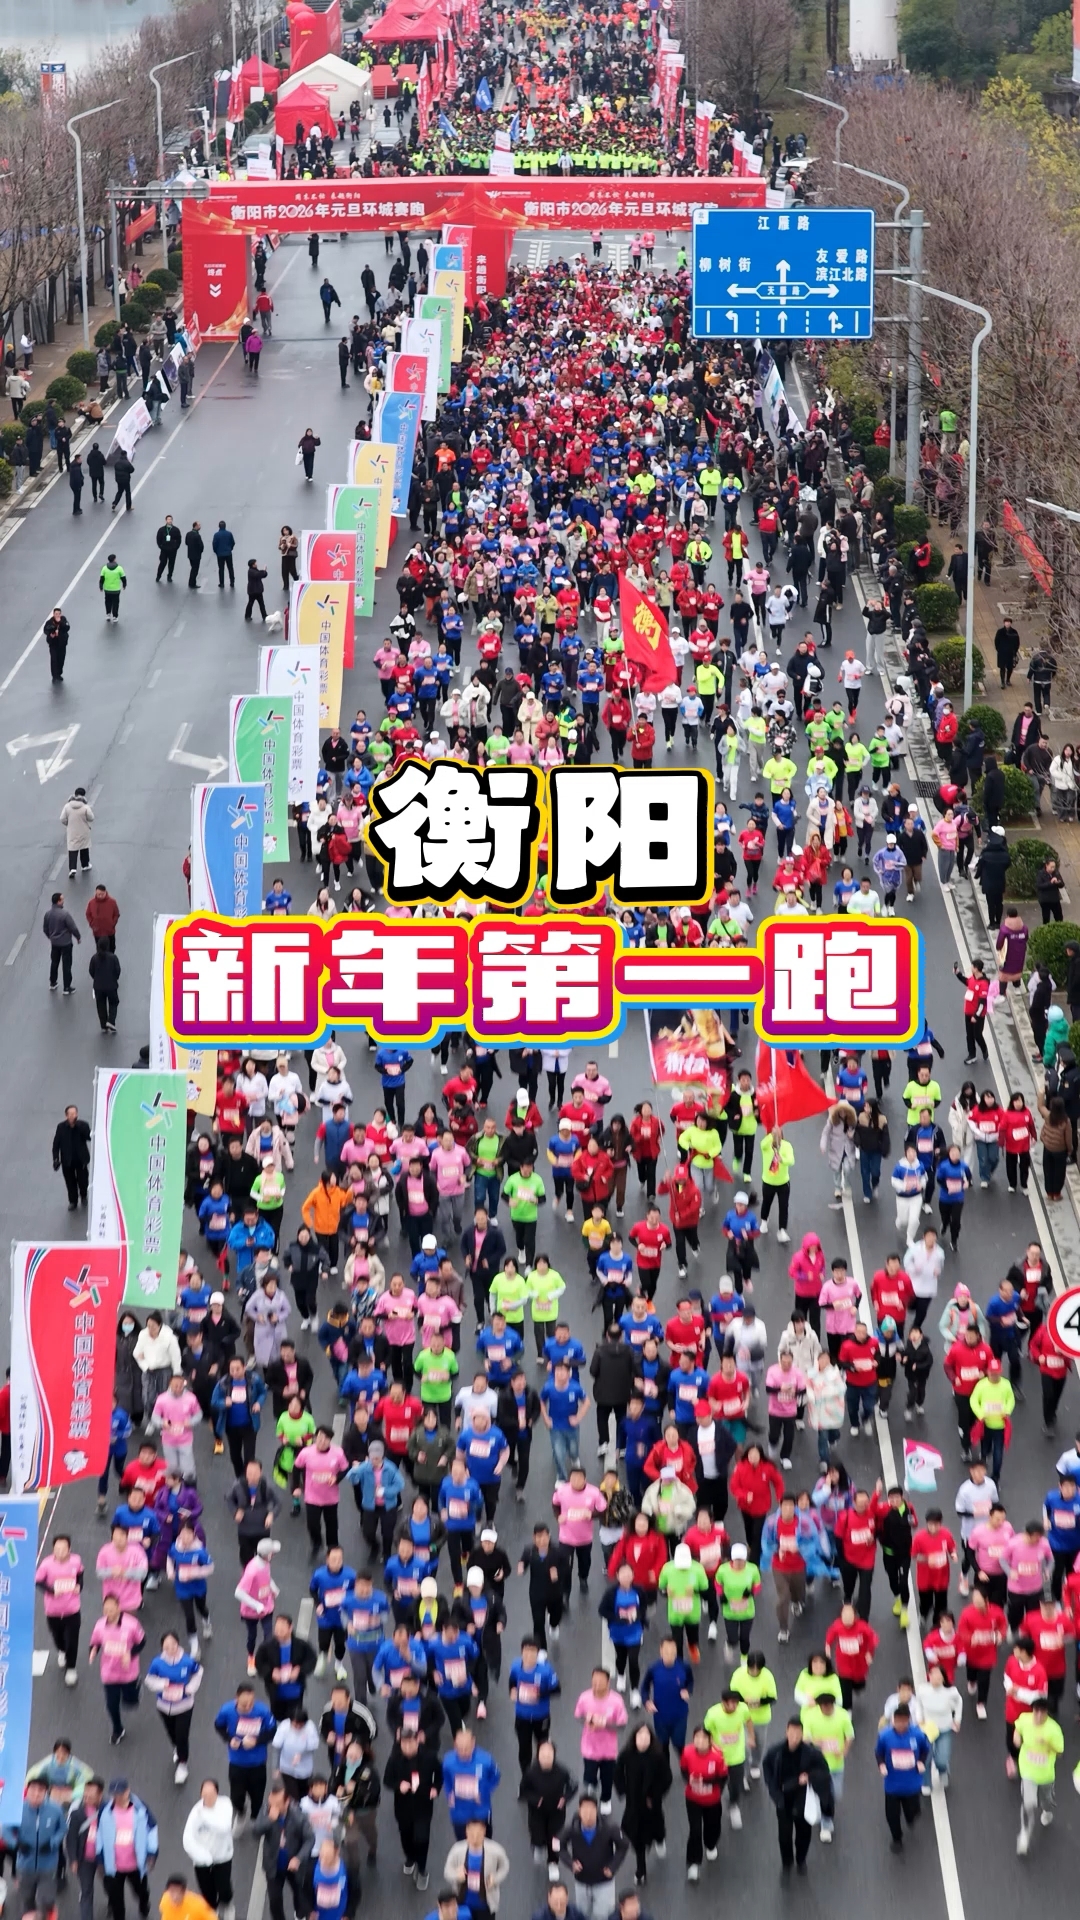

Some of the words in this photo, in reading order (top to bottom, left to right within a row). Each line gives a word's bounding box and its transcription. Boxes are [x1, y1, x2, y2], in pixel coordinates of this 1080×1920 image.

[231, 202, 425, 220] 衡阳市2026年元旦环城赛跑
[758, 215, 810, 231] 江雁路
[699, 257, 751, 273] 柳树街
[816, 249, 868, 264] 友爱路
[816, 267, 868, 282] 滨江北路
[319, 620, 331, 694] 中国体育彩票
[291, 690, 305, 771] 中国体育彩票
[143, 1133, 167, 1255] 中国体育彩票
[69, 1310, 95, 1441] 中国体育彩票
